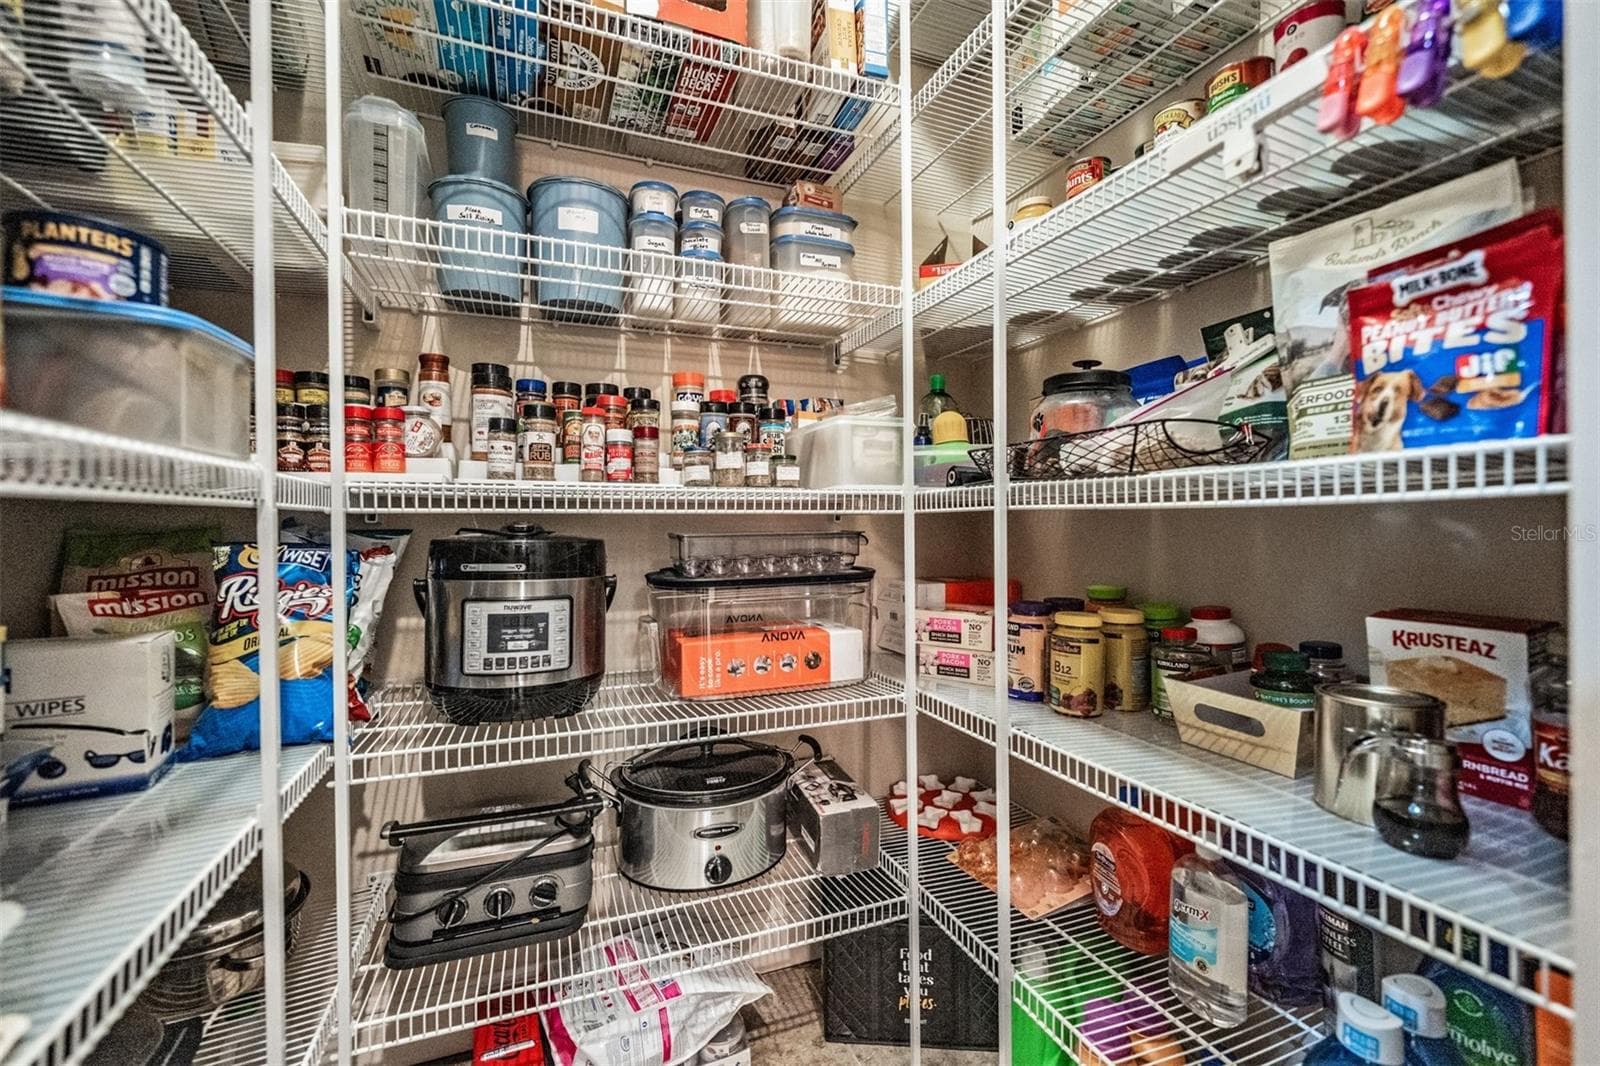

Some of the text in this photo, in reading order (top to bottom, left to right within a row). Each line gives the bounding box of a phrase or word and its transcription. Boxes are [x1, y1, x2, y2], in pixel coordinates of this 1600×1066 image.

[680, 76, 720, 93] DECAF
[684, 66, 724, 84] HOUSE
[21, 220, 134, 258] PLANTERS
[1399, 262, 1479, 298] MILK-BONE
[1361, 316, 1430, 343] PEANUT
[1435, 282, 1534, 326] BUTTER
[1362, 308, 1528, 376] BITES
[1458, 348, 1516, 378] Jif
[529, 451, 551, 460] RUB
[282, 549, 322, 568] WISE
[761, 630, 805, 643] ANOVA
[968, 623, 982, 631] NO
[1392, 629, 1497, 660] KRUSTEAZ
[977, 658, 991, 667] NO
[1054, 660, 1072, 675] B12
[15, 697, 86, 718] WIPES
[1462, 759, 1529, 783] RNBREAD
[898, 972, 934, 985] taes
